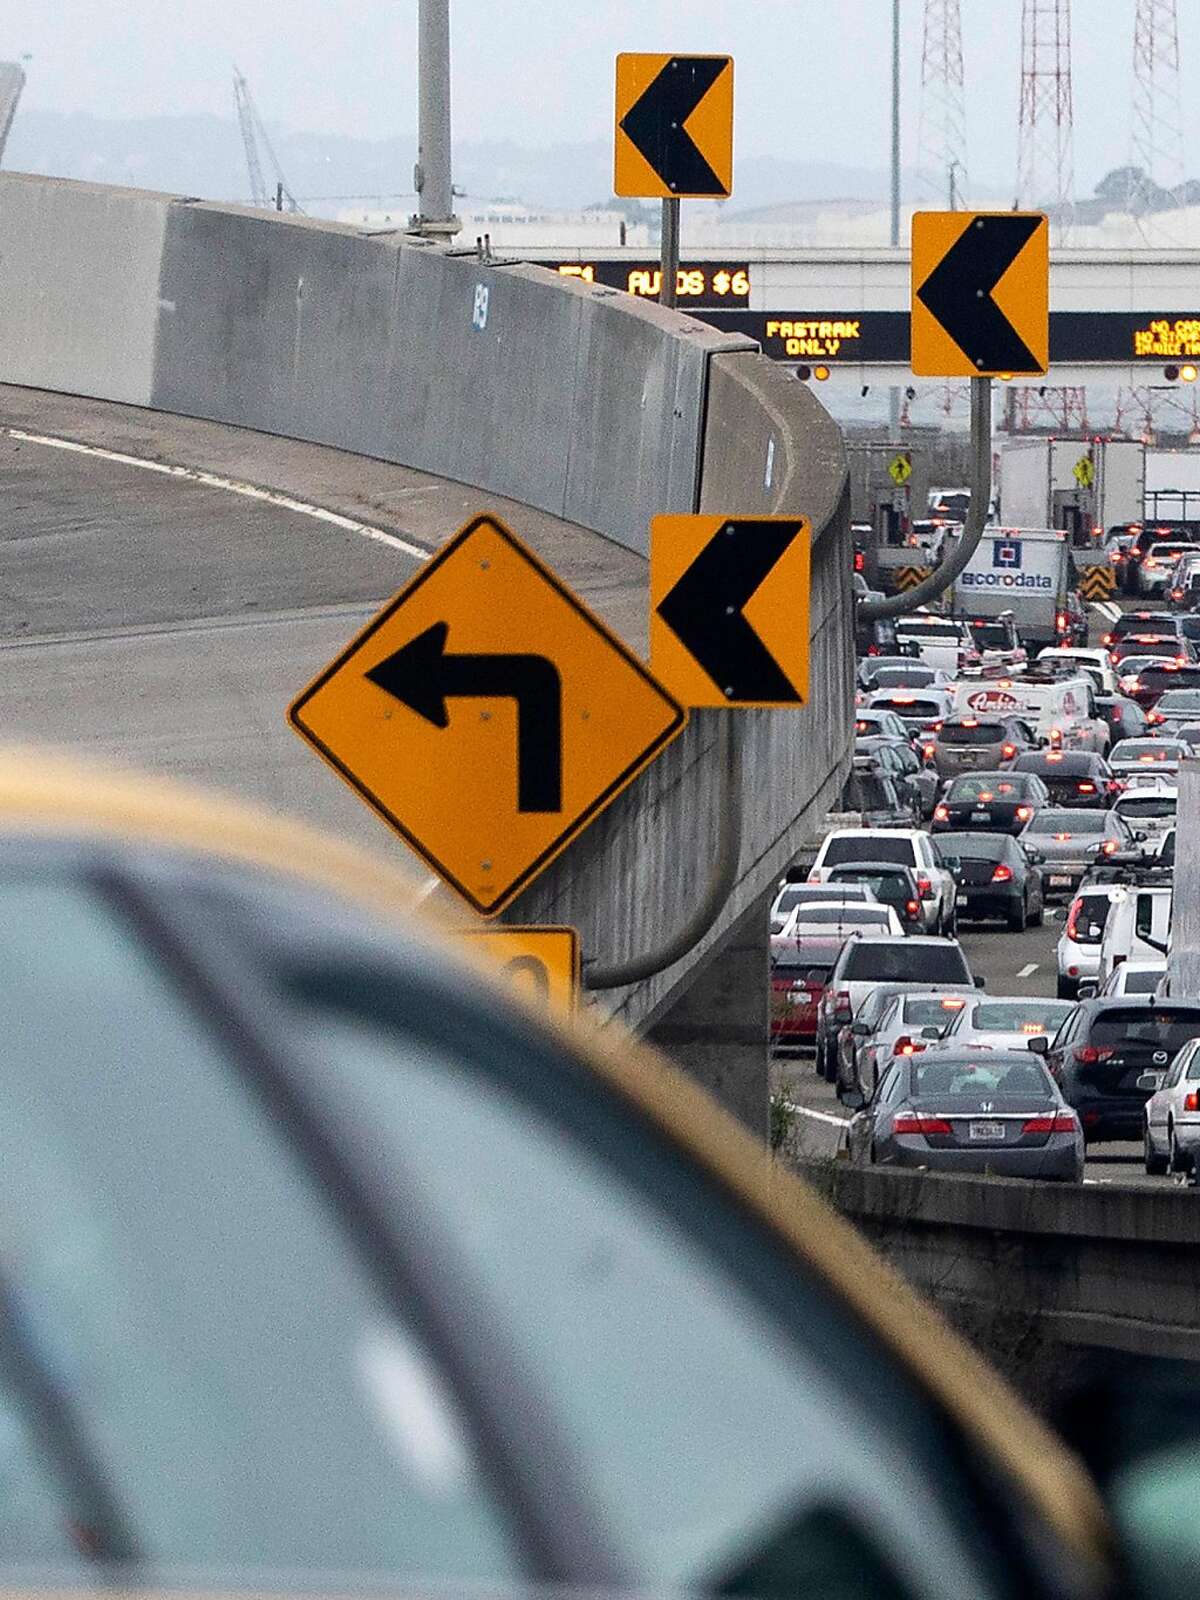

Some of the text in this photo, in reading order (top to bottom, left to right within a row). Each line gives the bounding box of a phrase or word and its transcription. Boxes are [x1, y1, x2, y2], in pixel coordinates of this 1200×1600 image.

[628, 270, 750, 296] AUOS $6
[766, 321, 860, 338] FASTRAK
[786, 338, 840, 355] ONLY
